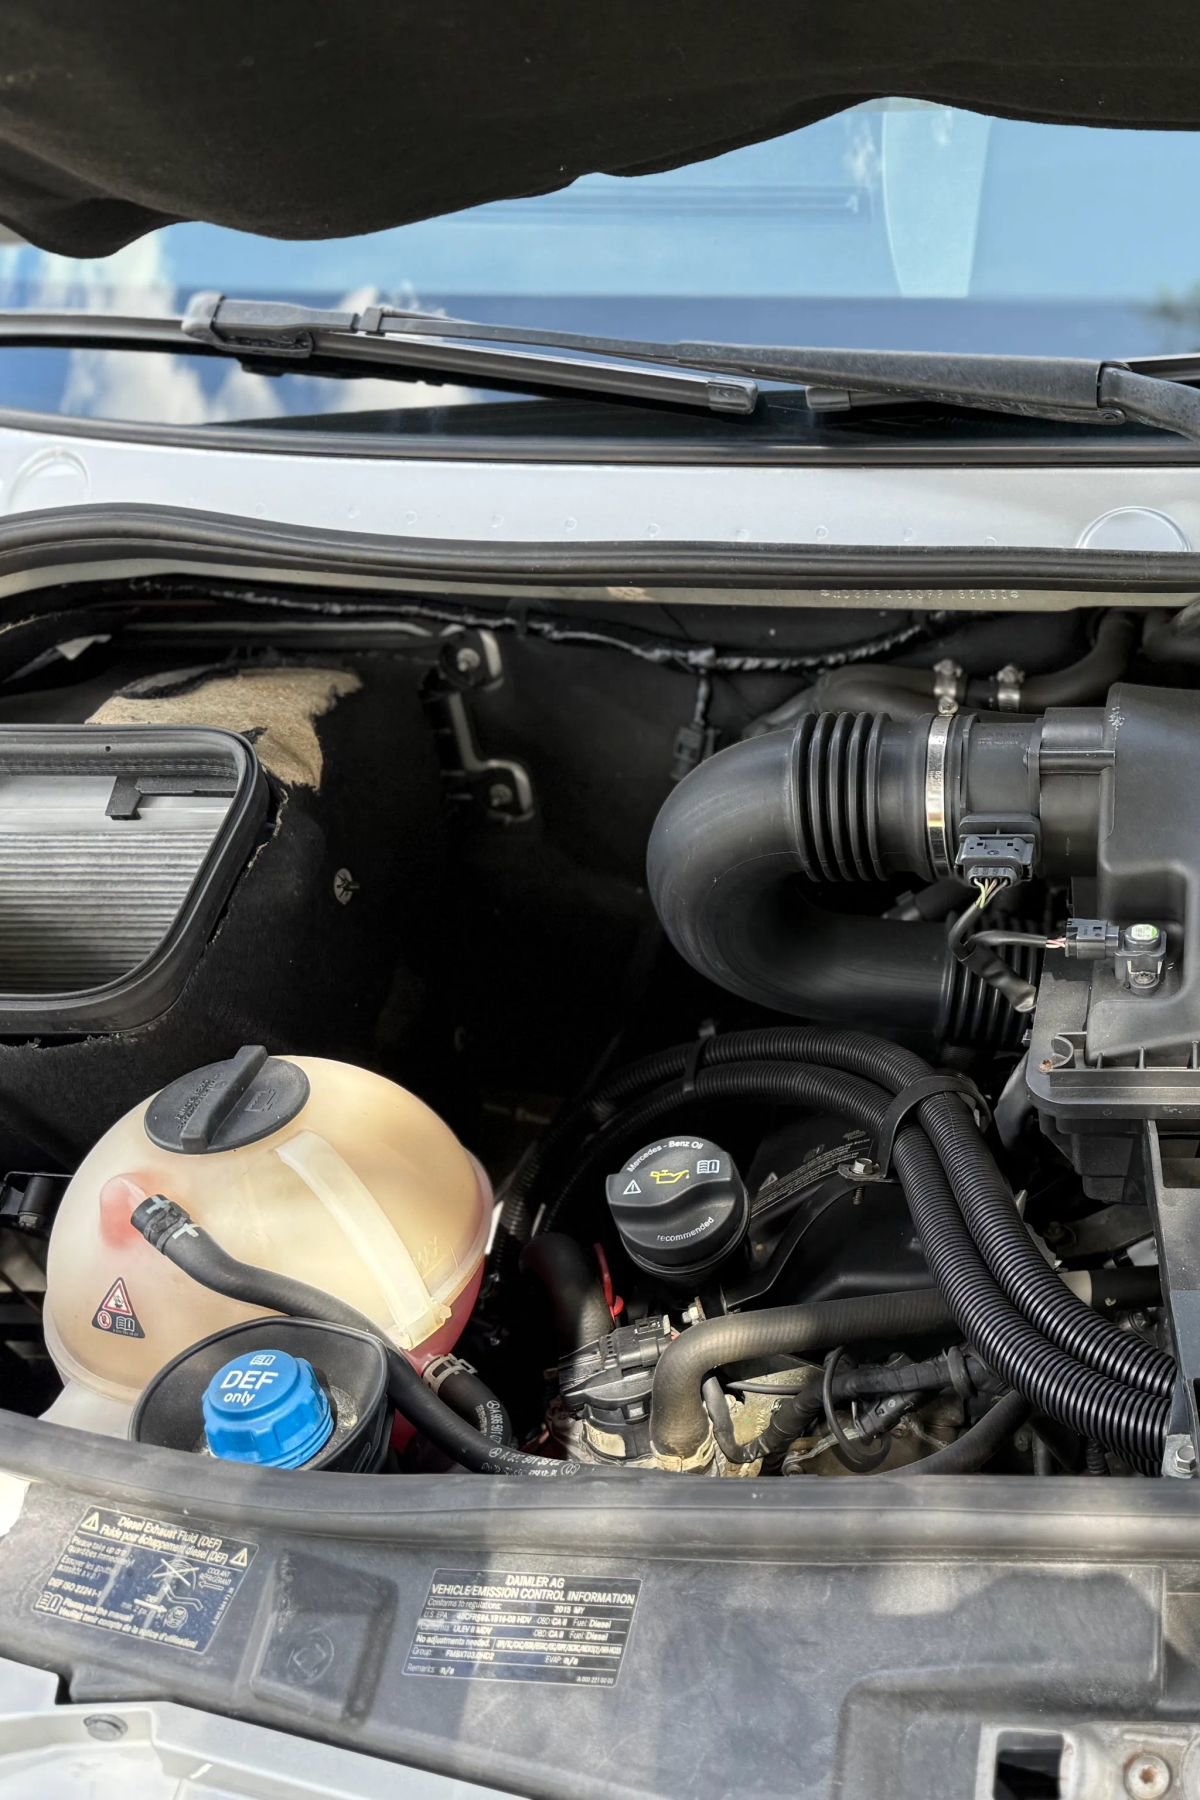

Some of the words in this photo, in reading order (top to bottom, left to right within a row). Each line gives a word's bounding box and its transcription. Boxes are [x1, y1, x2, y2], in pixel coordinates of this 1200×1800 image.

[627, 1145, 662, 1172] Mercedes
[668, 1140, 690, 1148] Benz
[691, 1141, 704, 1149] Oil
[656, 1216, 715, 1242] recommended
[220, 1370, 279, 1390] DEF
[223, 1391, 256, 1406] only
[117, 1517, 144, 1530] Diesel
[144, 1523, 177, 1538] Exhaust
[177, 1531, 198, 1543] Fluid
[197, 1536, 222, 1550] (DEF)
[99, 1525, 123, 1538] Fluide
[120, 1531, 138, 1543] pour
[184, 1546, 208, 1559] diesel
[207, 1551, 228, 1564] (DEF)
[48, 1578, 63, 1587] DEF
[62, 1582, 75, 1590] ISO
[506, 1576, 548, 1586] DAIMLER
[549, 1578, 564, 1587] AG
[431, 1584, 470, 1594] VEHICLE
[472, 1587, 518, 1597] EMISSION
[520, 1590, 565, 1599] CONTROL
[567, 1592, 633, 1603] INFORMATION
